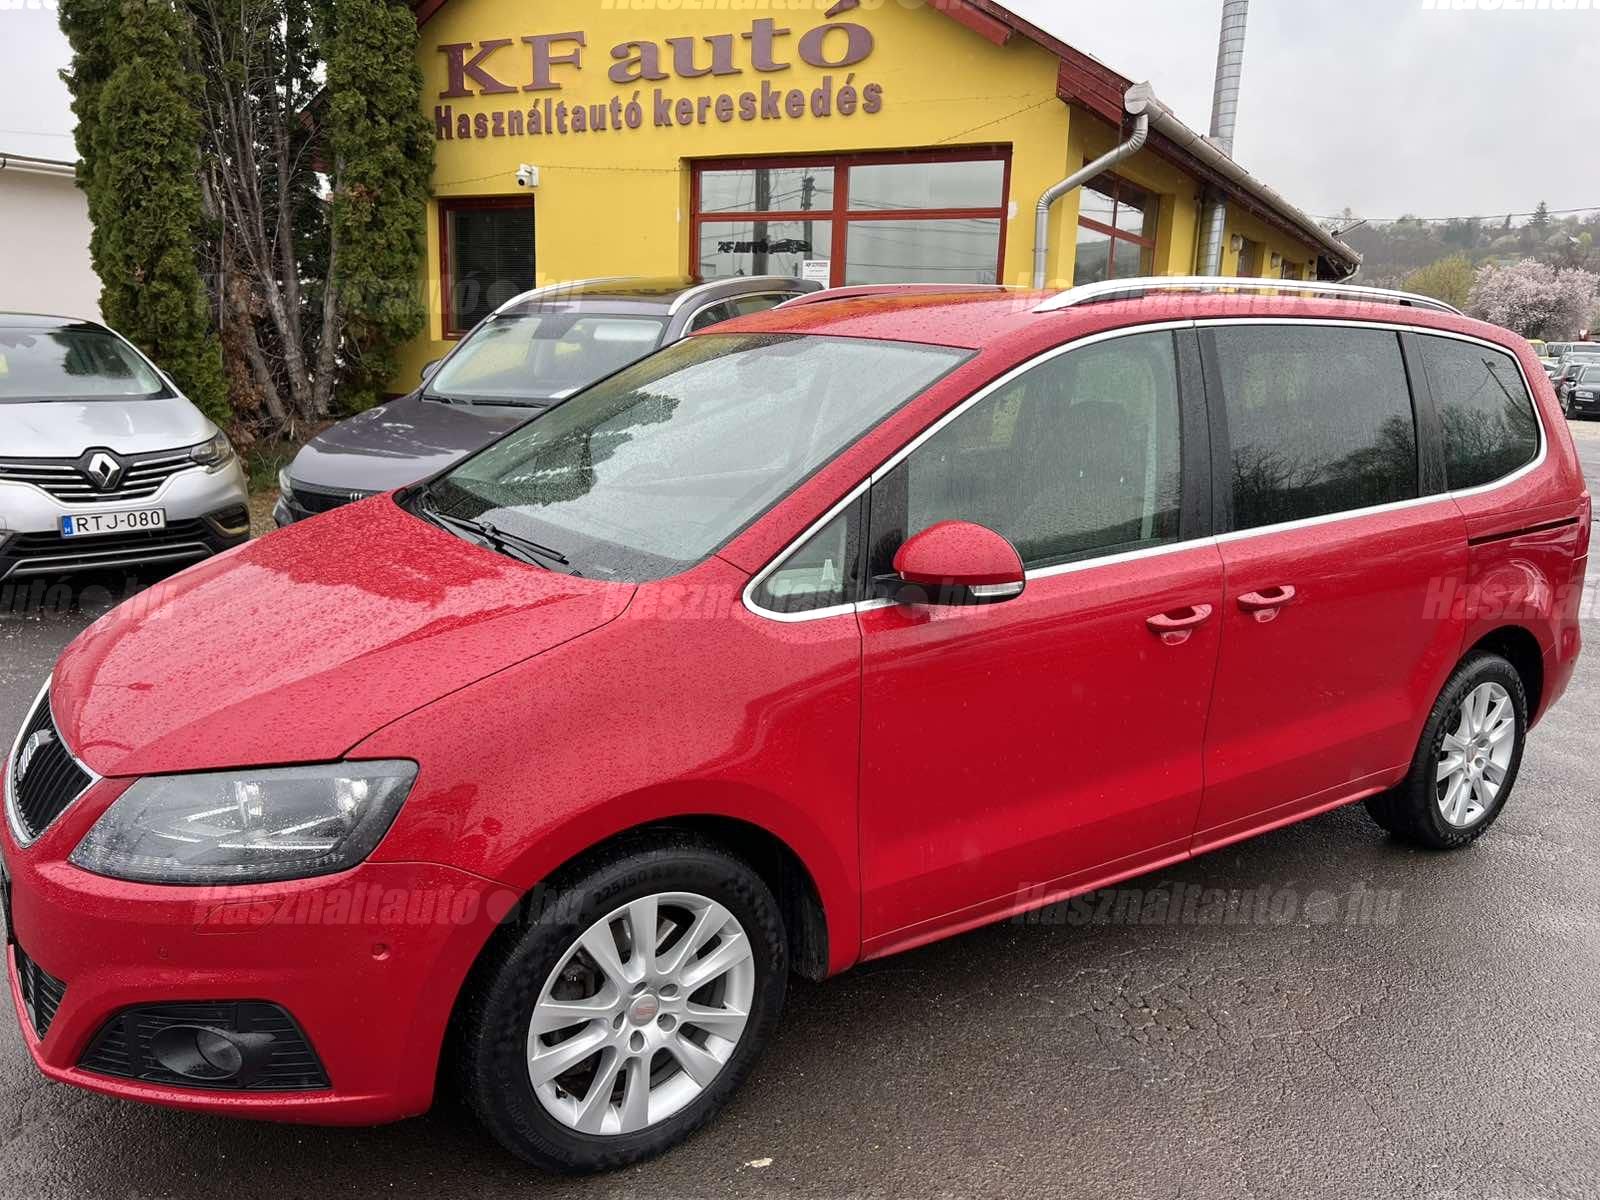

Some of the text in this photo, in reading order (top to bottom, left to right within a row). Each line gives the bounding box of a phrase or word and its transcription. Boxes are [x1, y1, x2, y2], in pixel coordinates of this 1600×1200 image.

[437, 0, 875, 99] KF autó
[434, 73, 884, 141] Használtautó kereskedés
[77, 510, 160, 533] RTJ-080
